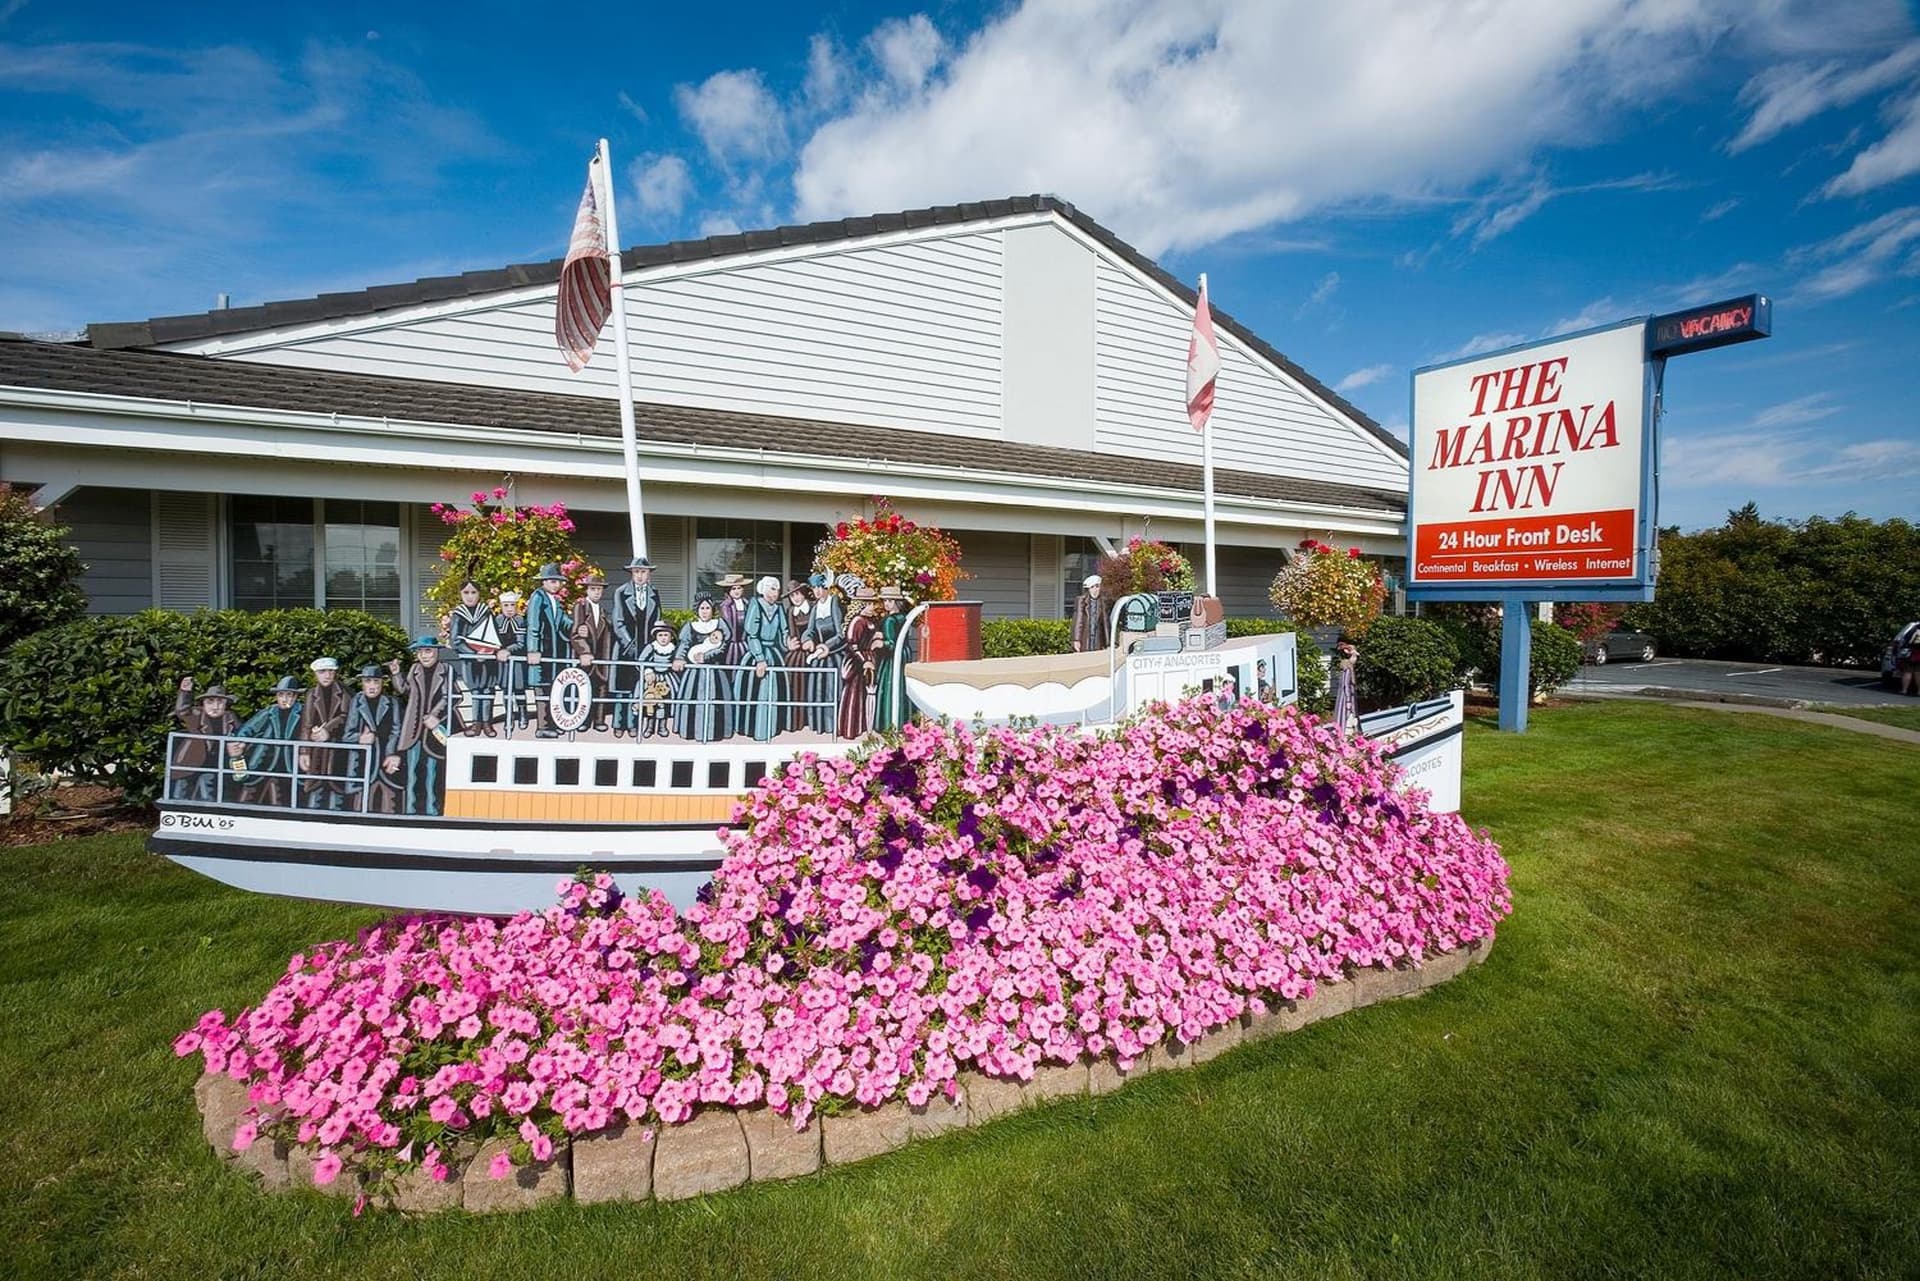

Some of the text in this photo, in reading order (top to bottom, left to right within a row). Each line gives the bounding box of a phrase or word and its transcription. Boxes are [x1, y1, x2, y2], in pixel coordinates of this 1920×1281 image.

[1680, 307, 1752, 338] VACANCY
[1468, 357, 1569, 417] THE
[1427, 400, 1620, 470] MARINA
[1468, 462, 1565, 513] INN
[1438, 520, 1604, 550] 24 Hour Front Desk
[1417, 557, 1631, 574] Continental Breakfast Wireless Internet
[1133, 657, 1154, 670] CITY
[1164, 653, 1222, 667] ANACORTES
